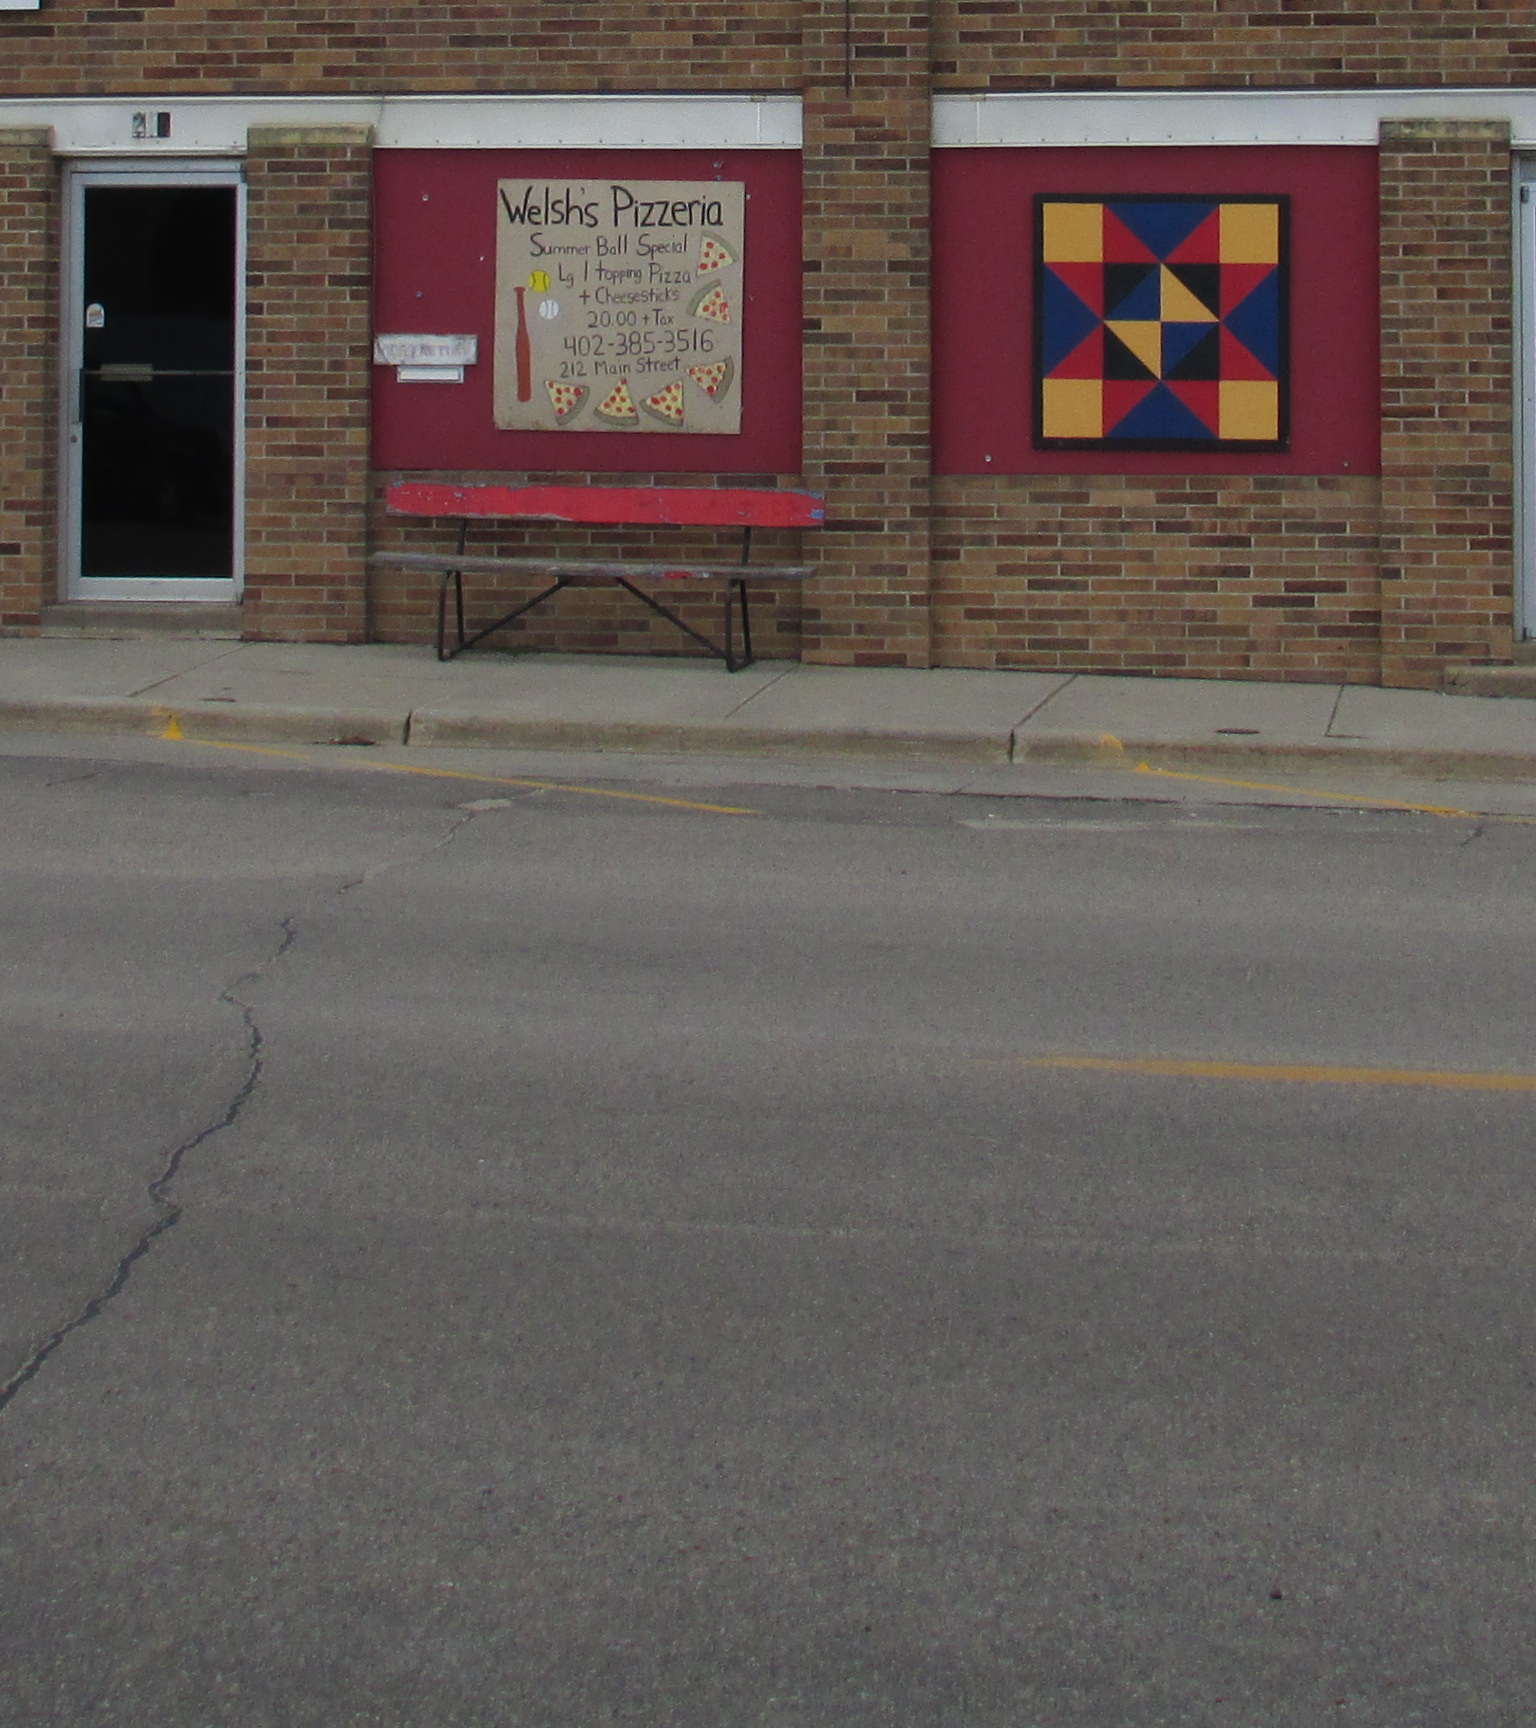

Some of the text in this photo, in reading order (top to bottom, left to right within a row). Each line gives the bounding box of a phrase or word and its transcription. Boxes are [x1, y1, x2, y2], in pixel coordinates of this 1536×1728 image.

[500, 185, 724, 228] Welsh's Pizzeria
[529, 233, 688, 260] Summer Ball Special
[558, 262, 574, 288] Lg
[595, 260, 642, 285] topping
[649, 262, 691, 284] Pizza
[595, 285, 680, 305] Cheesesticks
[587, 310, 637, 329] 20.00
[652, 308, 674, 326] Tax
[564, 328, 714, 357] 402-385-3516
[560, 356, 681, 378] 212 Main Street
